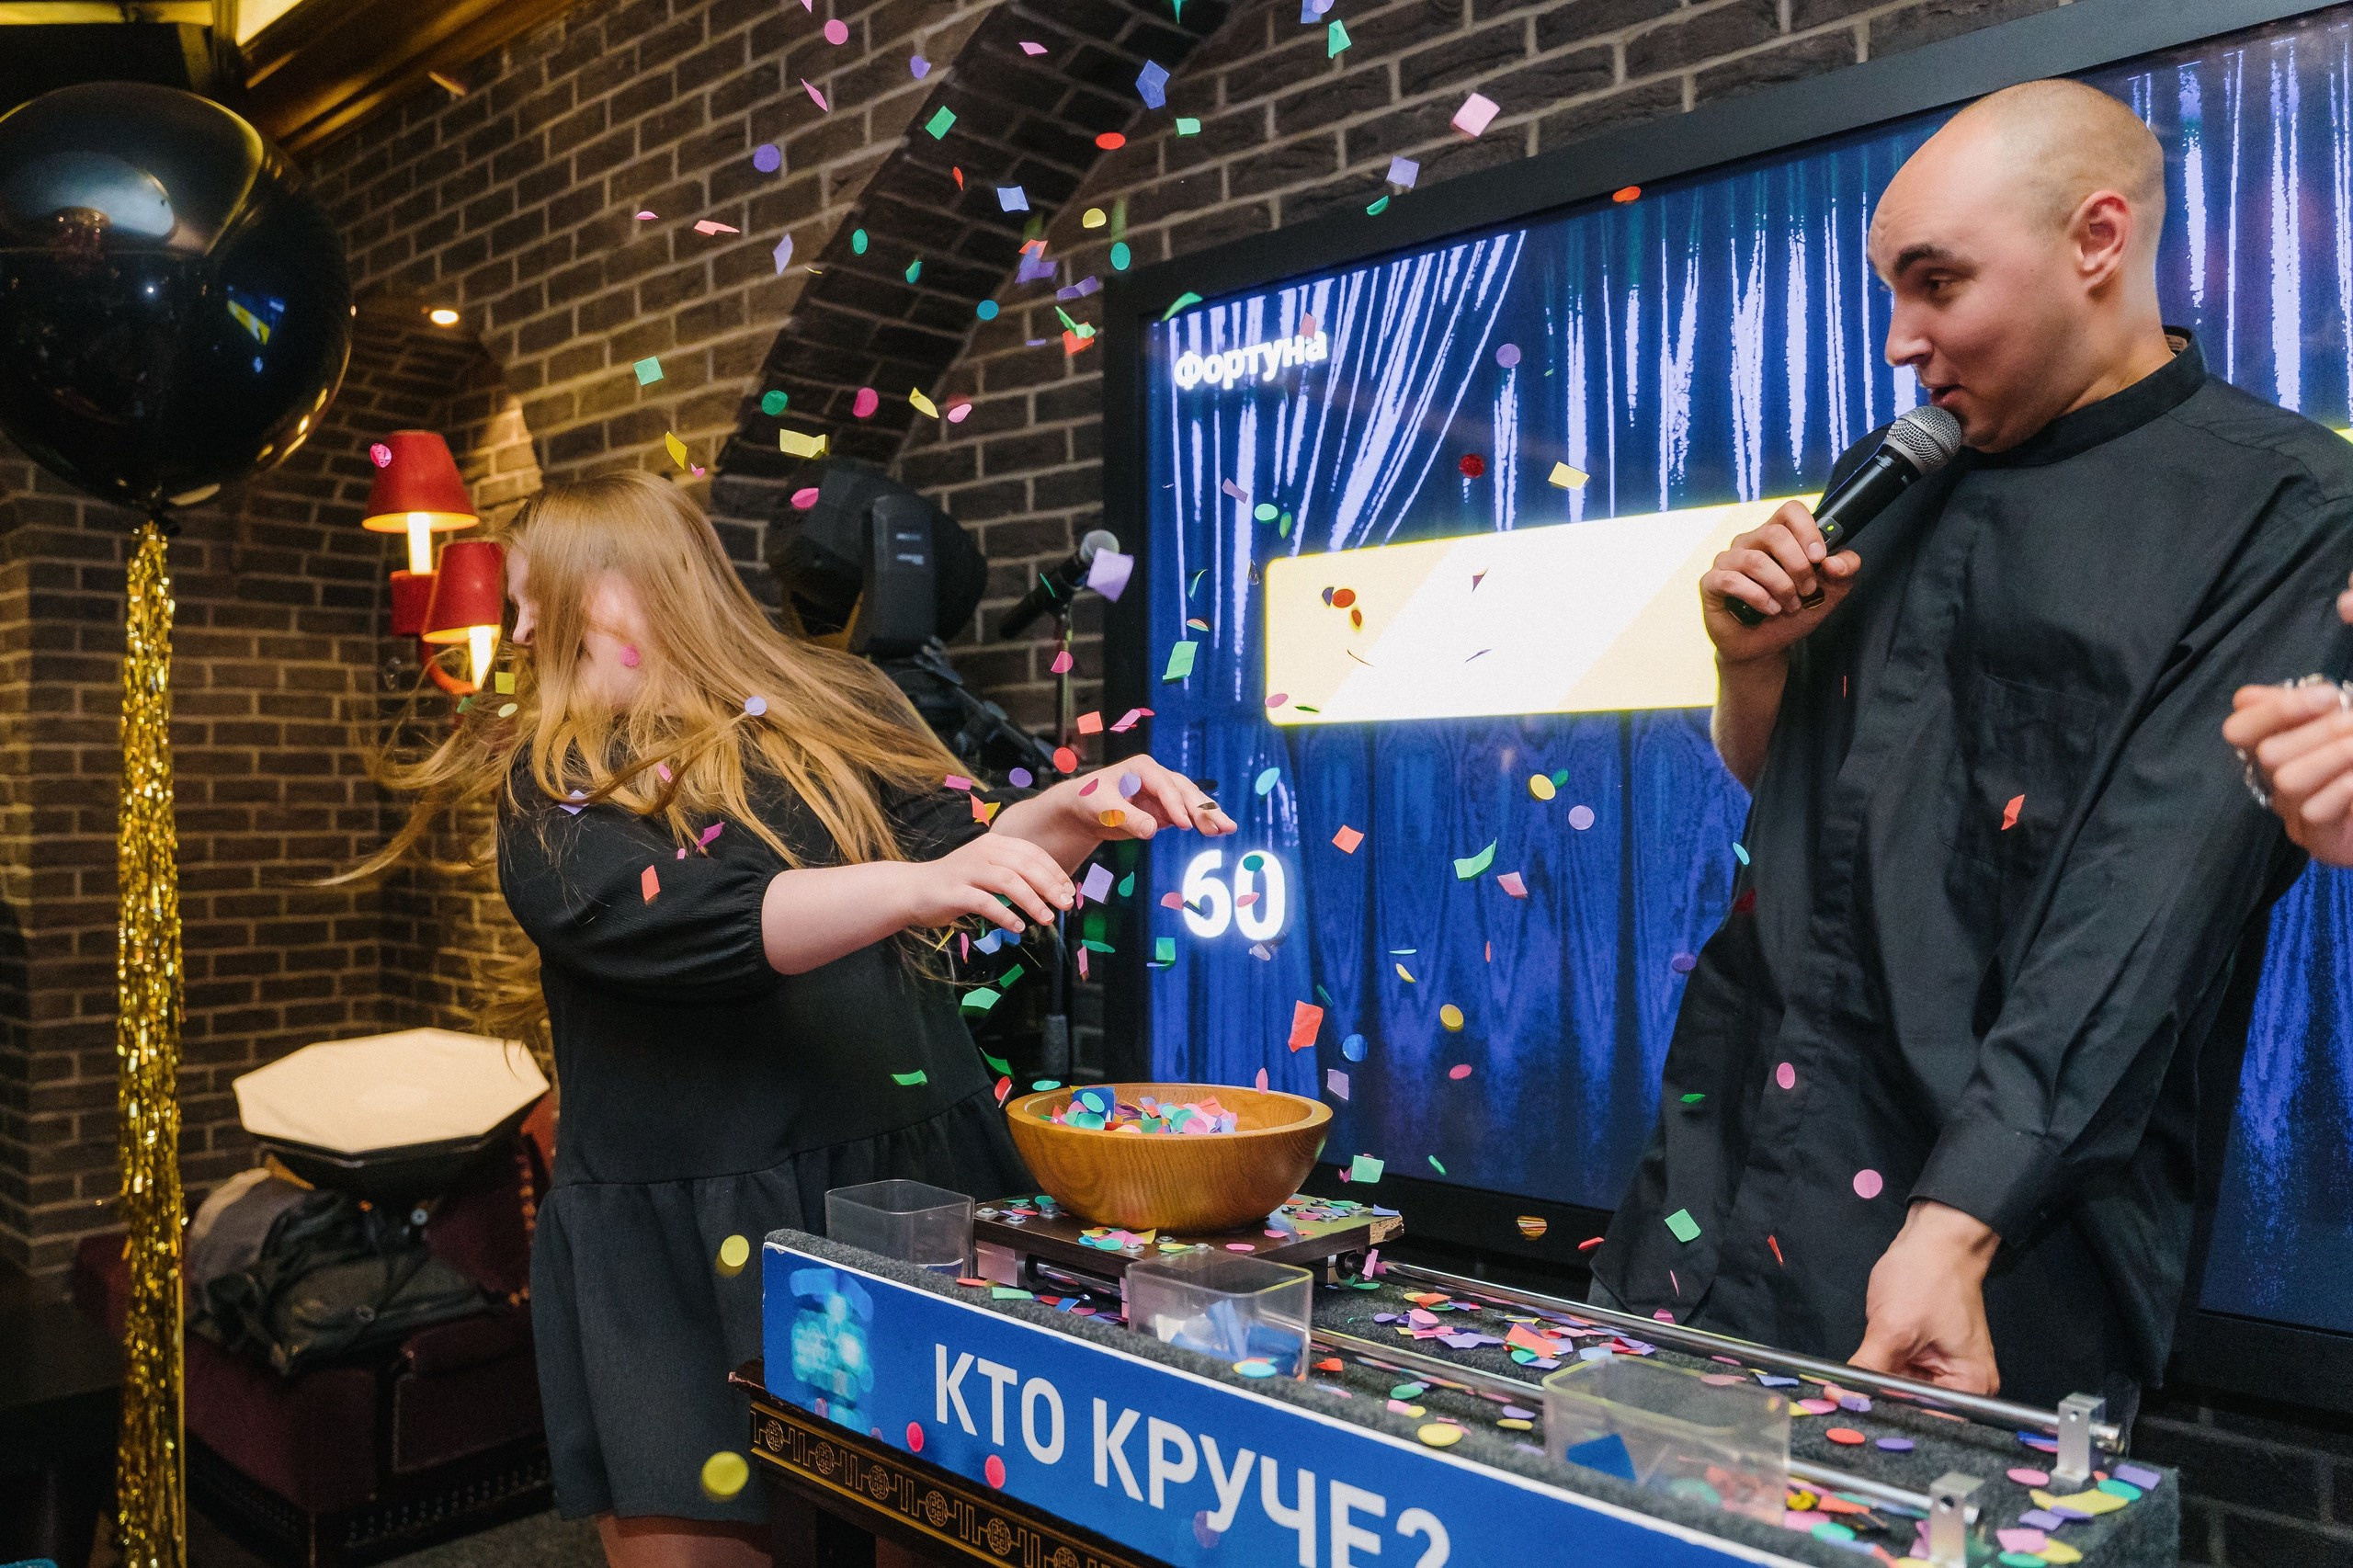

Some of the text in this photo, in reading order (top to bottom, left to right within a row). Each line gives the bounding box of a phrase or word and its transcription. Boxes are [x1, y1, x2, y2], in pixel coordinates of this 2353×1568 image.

[1174, 330, 1328, 391] Фортуна
[1182, 848, 1286, 941] 60
[935, 1343, 1451, 1568] КТО КРУЧЕ?
